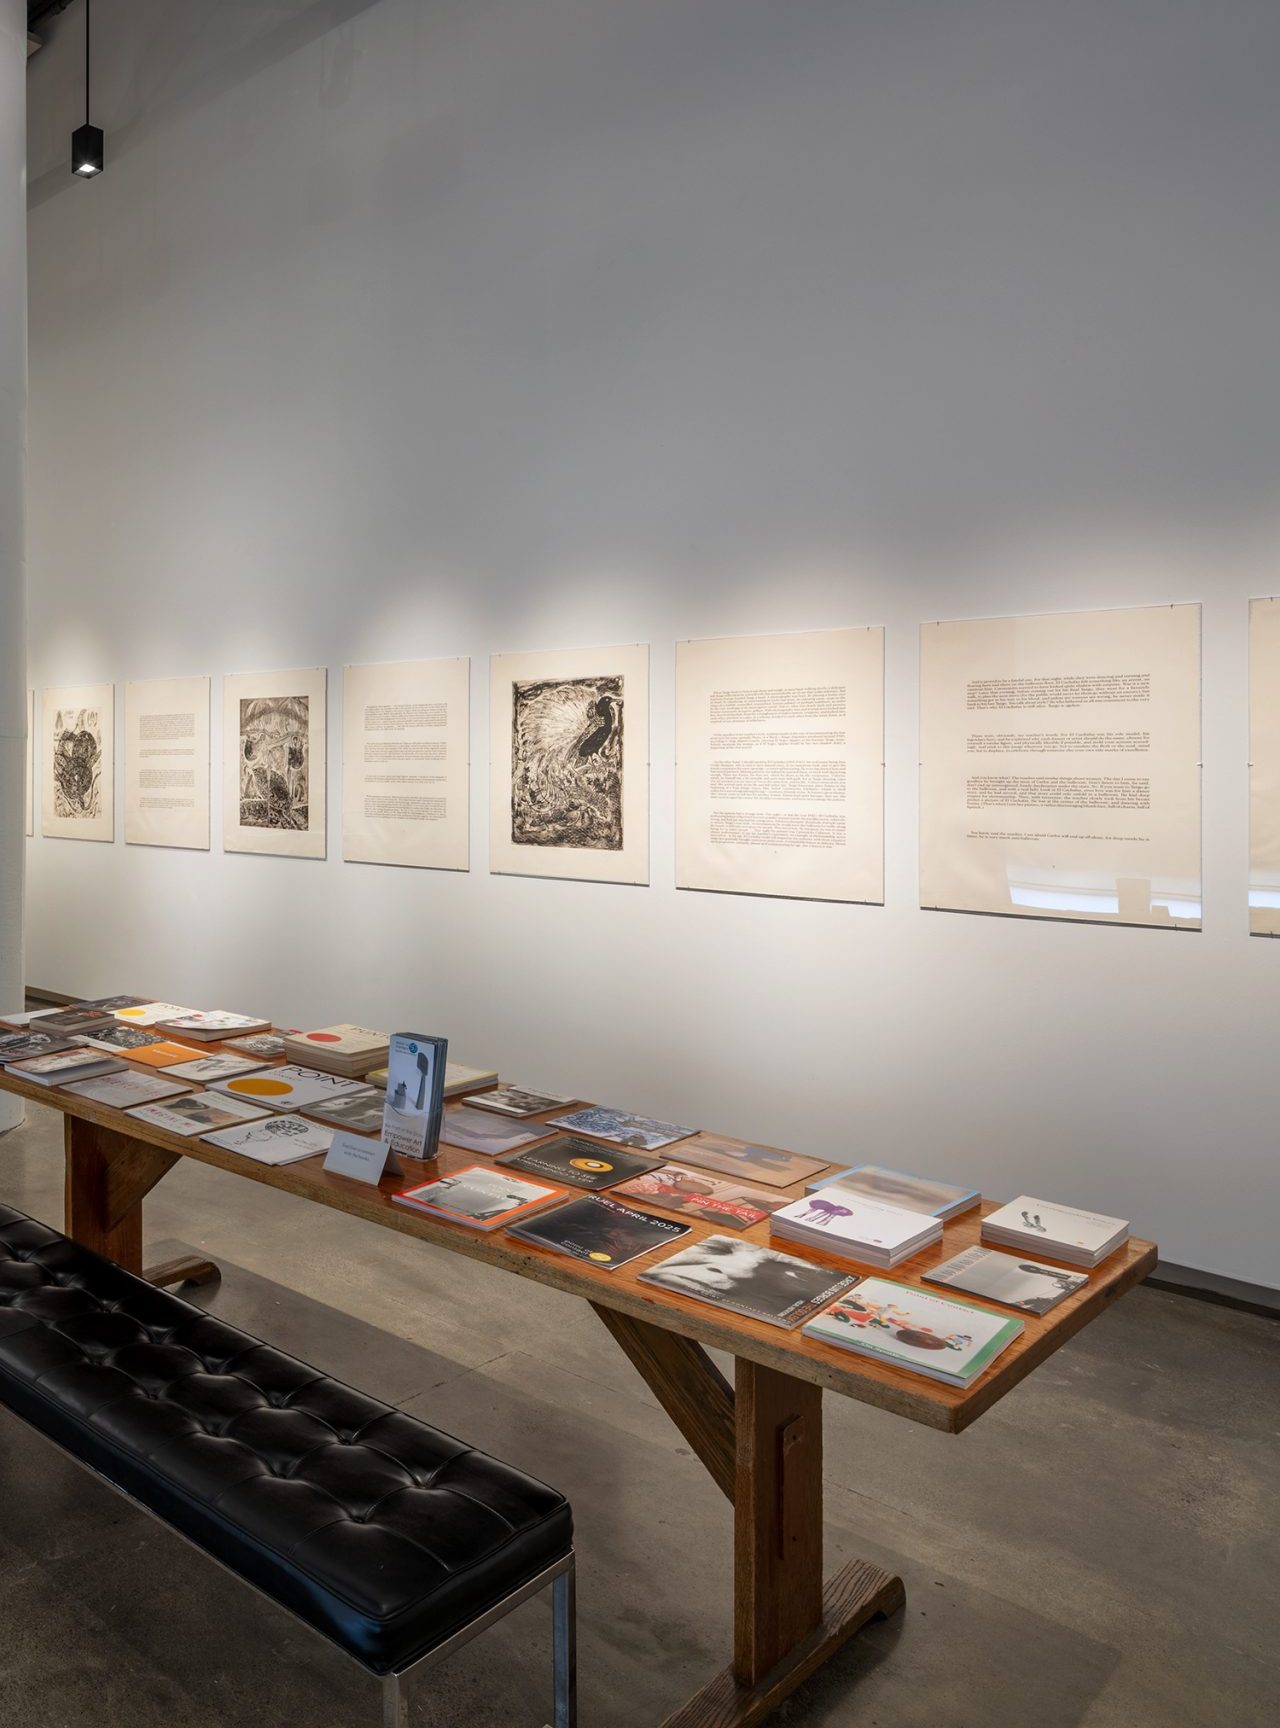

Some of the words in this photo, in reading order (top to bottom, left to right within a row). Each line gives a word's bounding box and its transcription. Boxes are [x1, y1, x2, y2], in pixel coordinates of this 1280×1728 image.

[281, 1066, 360, 1088] POINT
[384, 1130, 413, 1144] Empower
[413, 1138, 422, 1146] Art
[390, 1139, 421, 1154] Education
[616, 1207, 648, 1223] APRIL
[650, 1219, 681, 1233] 2025
